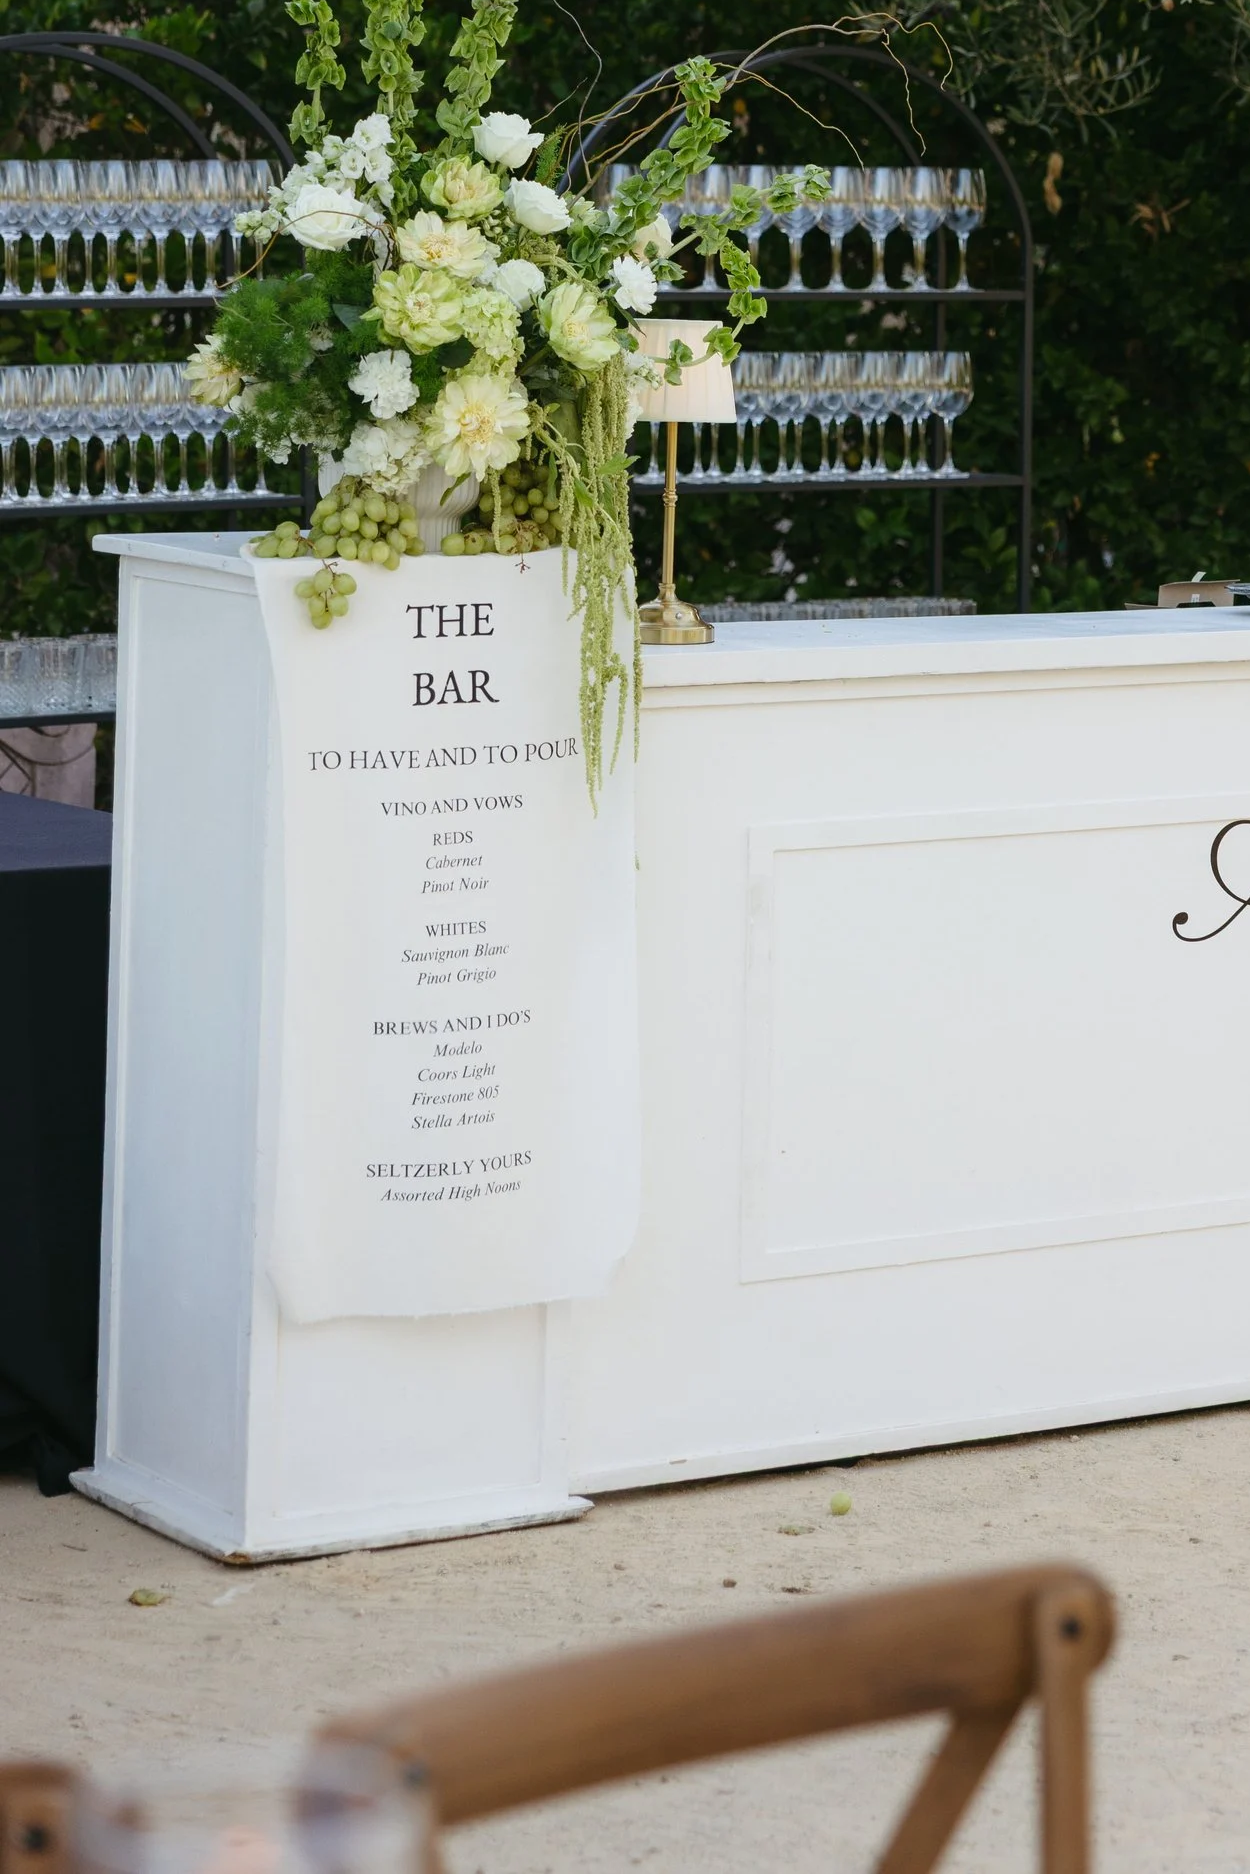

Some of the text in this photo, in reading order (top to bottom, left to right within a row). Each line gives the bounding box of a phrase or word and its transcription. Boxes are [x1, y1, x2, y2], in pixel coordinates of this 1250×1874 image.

[406, 603, 494, 638] THE
[412, 669, 500, 706] BAR
[308, 737, 579, 770] TO HAVE AND TO POUR
[381, 794, 524, 816] VINO AND VOWS
[432, 830, 474, 846] REDS
[426, 855, 483, 870] Cabernet
[421, 877, 489, 894] Pinot Noir
[426, 921, 487, 937] WHITES
[401, 943, 510, 963] Sauvignon Blanc
[417, 968, 496, 986] Pinot Grigio
[374, 1020, 438, 1035] BREWS
[443, 1016, 482, 1033] AND
[487, 1015, 491, 1029] I
[433, 1041, 482, 1057] Modelo
[418, 1063, 496, 1082] Coors Light
[412, 1085, 500, 1106] Firestone 805
[411, 1111, 495, 1129] Stella Artois
[366, 1150, 532, 1178] SELTZERLY YOURS
[381, 1180, 521, 1202] Assorted High Noons
